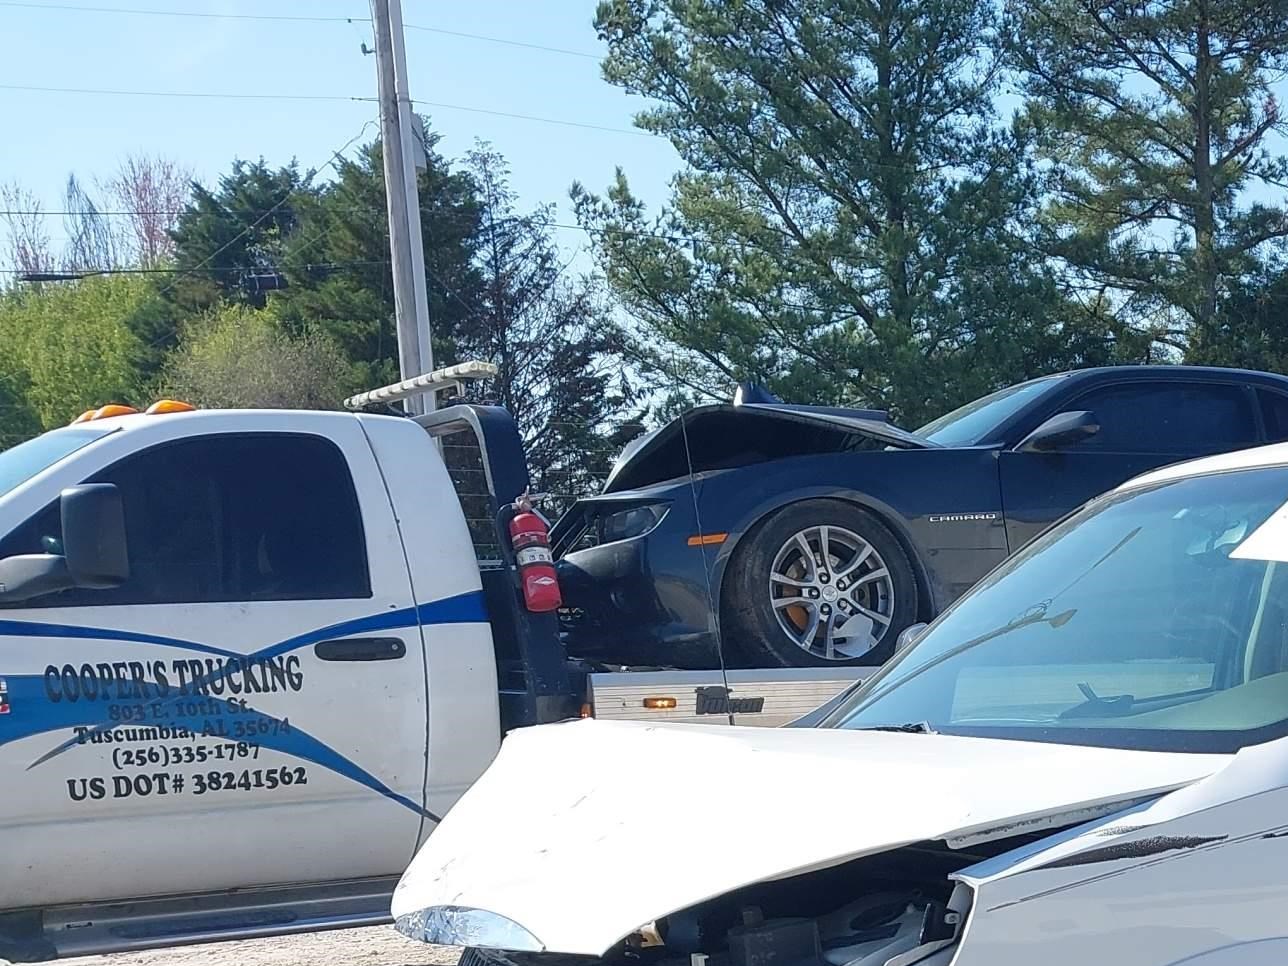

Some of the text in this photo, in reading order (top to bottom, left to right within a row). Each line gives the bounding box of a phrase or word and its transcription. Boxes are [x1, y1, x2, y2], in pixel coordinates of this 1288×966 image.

[45, 660, 168, 703] COOPER'S
[172, 655, 304, 695] TRUCKING
[73, 721, 196, 744] Tuscumbia,
[112, 741, 260, 769] (256)335-1787
[67, 765, 307, 801] US DOT# 38241562
